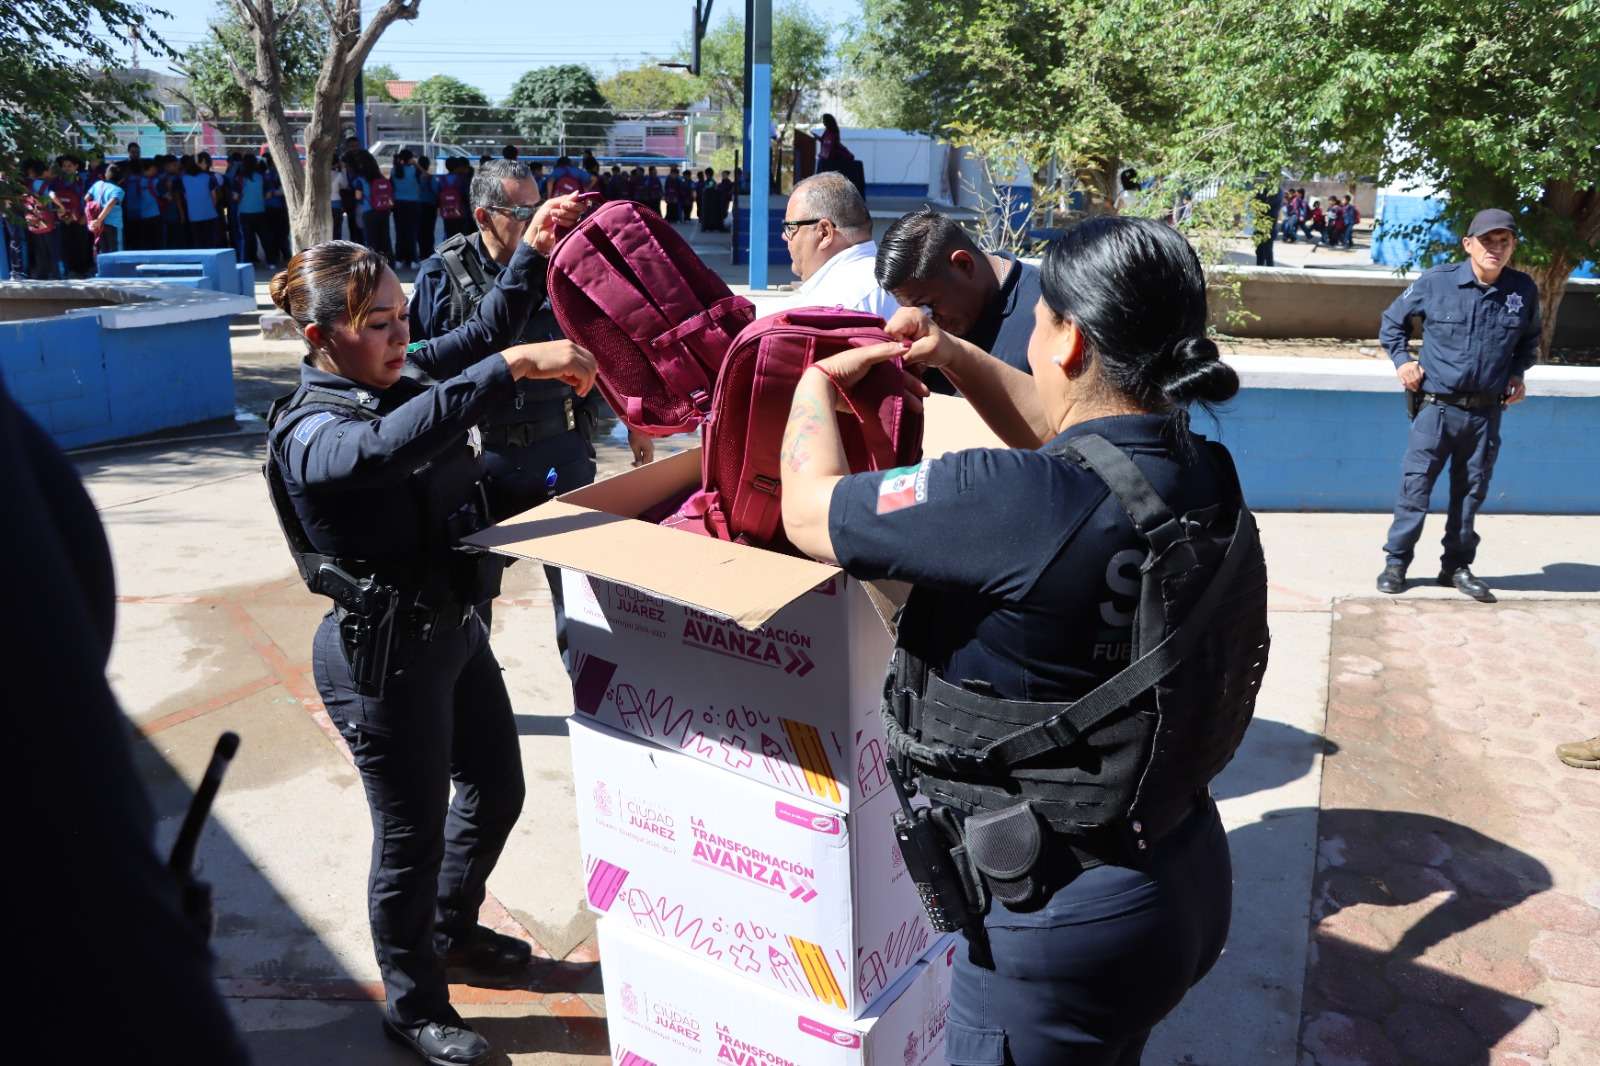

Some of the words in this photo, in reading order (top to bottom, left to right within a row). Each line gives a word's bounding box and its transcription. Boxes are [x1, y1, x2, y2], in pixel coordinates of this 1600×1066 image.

[616, 598, 666, 623] JUÁREZ
[682, 618, 782, 665] AVANZA
[627, 801, 675, 828] CIUDAD
[690, 815, 705, 829] LA
[629, 815, 676, 842] JUÁREZ
[690, 826, 815, 880] TRANSFORMACIÓN
[692, 840, 787, 891] AVANZA
[653, 1002, 701, 1031] CIUDAD
[655, 1015, 701, 1042] JUÁREZ
[715, 1021, 730, 1034] LA
[715, 1030, 802, 1066] TRANSFORM
